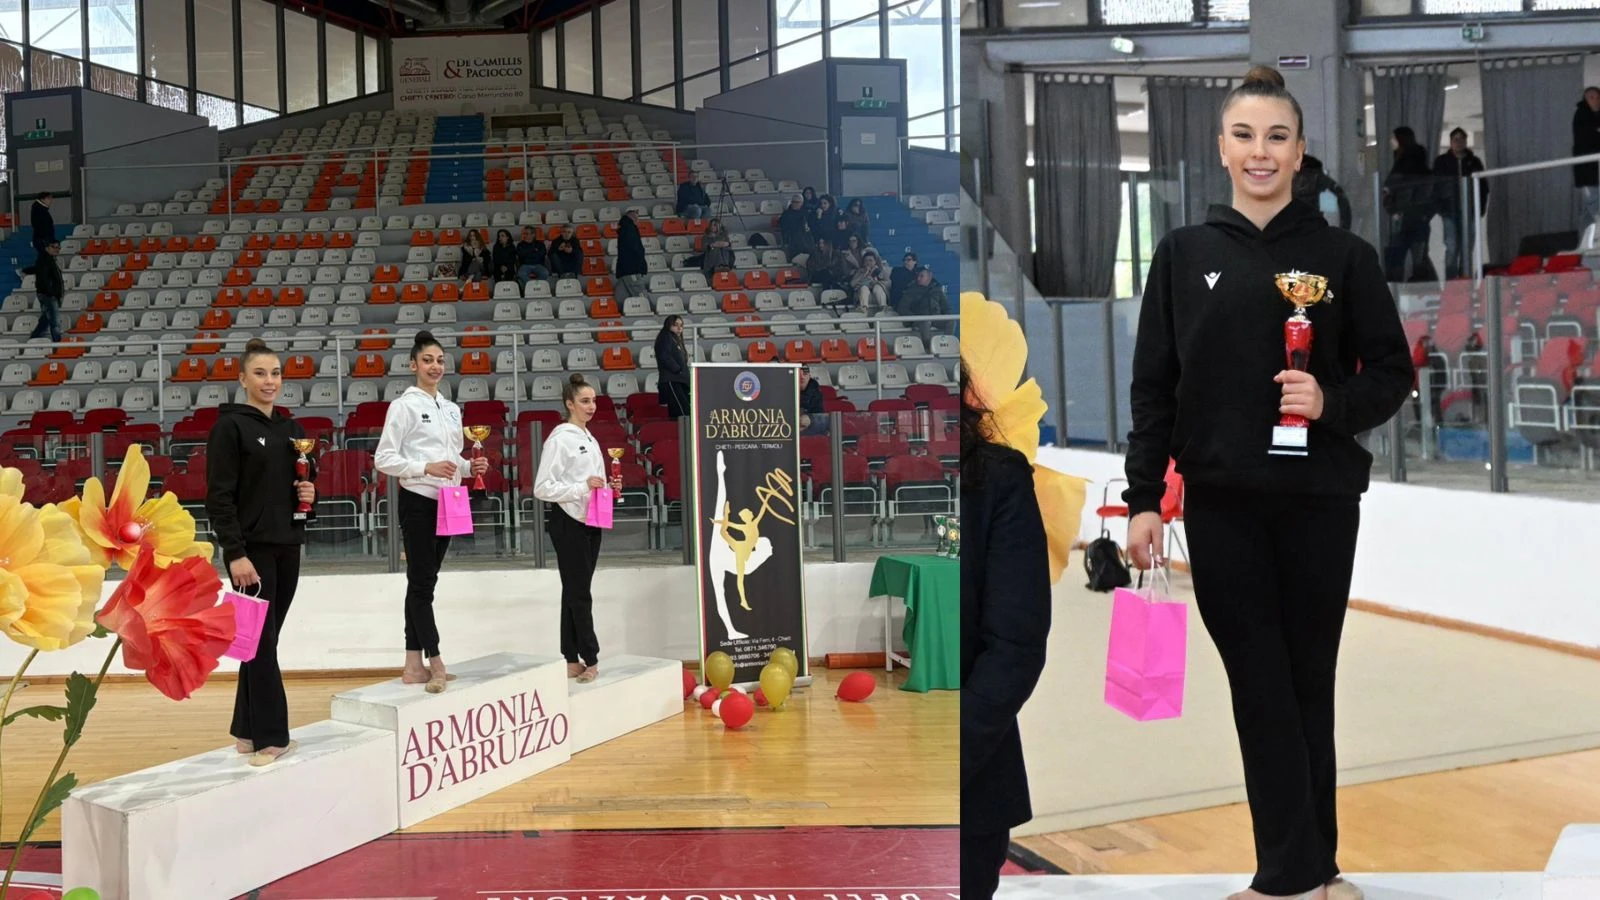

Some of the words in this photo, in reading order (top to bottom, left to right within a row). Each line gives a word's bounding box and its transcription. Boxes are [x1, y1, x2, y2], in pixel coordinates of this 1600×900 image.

[444, 59, 463, 79] &
[466, 67, 522, 78] PACIOCCO
[457, 58, 471, 68] DE
[474, 57, 522, 67] CAMILLIS
[710, 408, 787, 424] ARMONIA
[705, 423, 792, 439] D'ABRUZZO
[400, 688, 546, 766] ARMONIA
[407, 713, 569, 802] D'ABRUZZO
